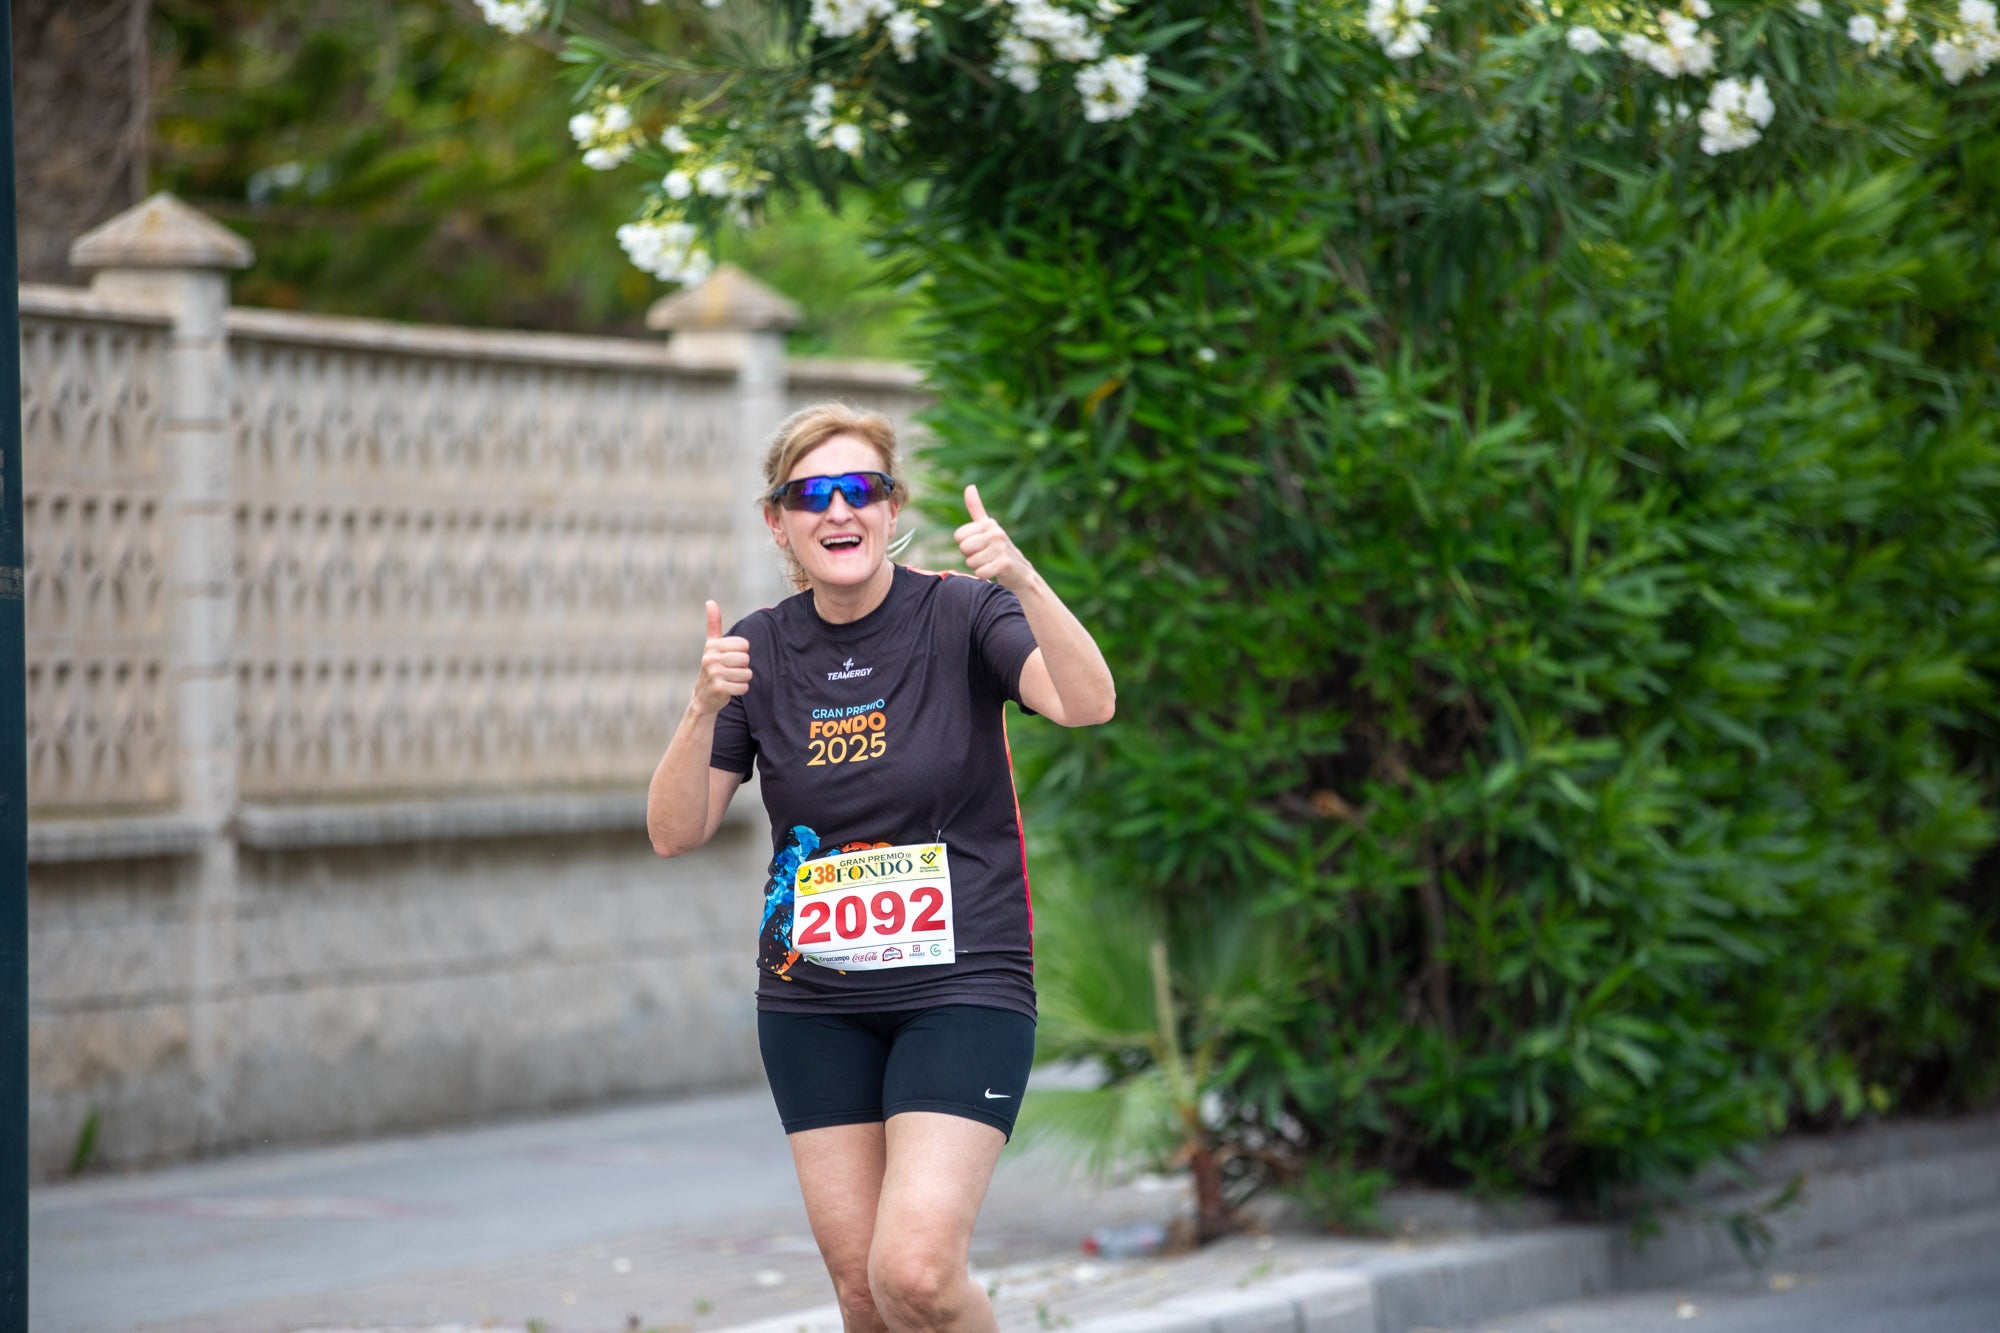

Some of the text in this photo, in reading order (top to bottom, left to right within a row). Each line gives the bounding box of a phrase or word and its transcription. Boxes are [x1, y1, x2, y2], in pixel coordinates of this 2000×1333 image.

[827, 667, 873, 680] TEAMERGY
[809, 711, 886, 738] FONDO
[812, 707, 843, 718] GRAN
[806, 731, 887, 766] 2025
[813, 863, 836, 885] 38
[836, 858, 913, 883] FONDO
[839, 857, 865, 867] GRAN
[867, 851, 905, 862] PREMIO
[797, 887, 946, 945] 2092
